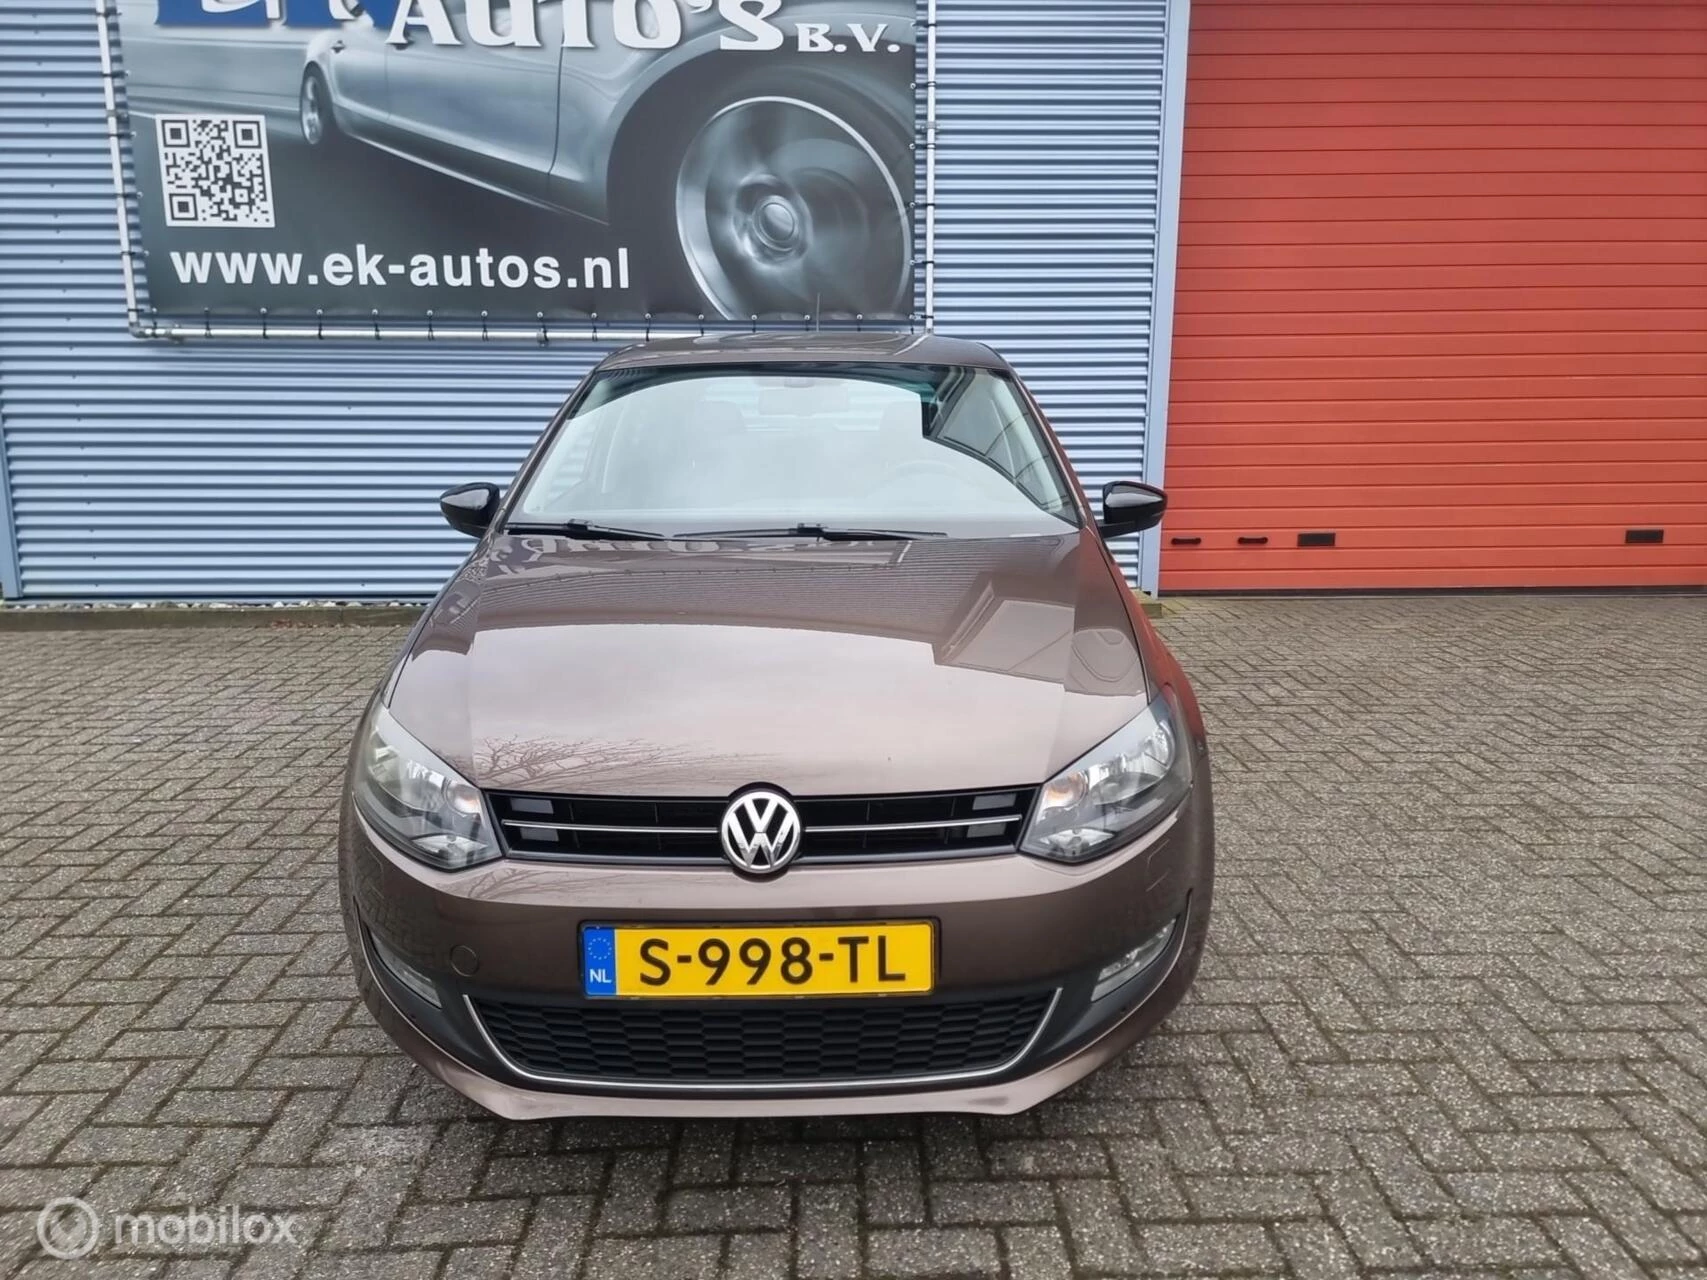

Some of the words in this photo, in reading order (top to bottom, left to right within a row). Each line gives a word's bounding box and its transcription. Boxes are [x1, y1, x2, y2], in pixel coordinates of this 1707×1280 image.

[798, 23, 901, 52] B.V.
[170, 244, 630, 289] www.ek-autos.nl
[589, 968, 612, 984] NL
[639, 935, 906, 986] S-998-TL
